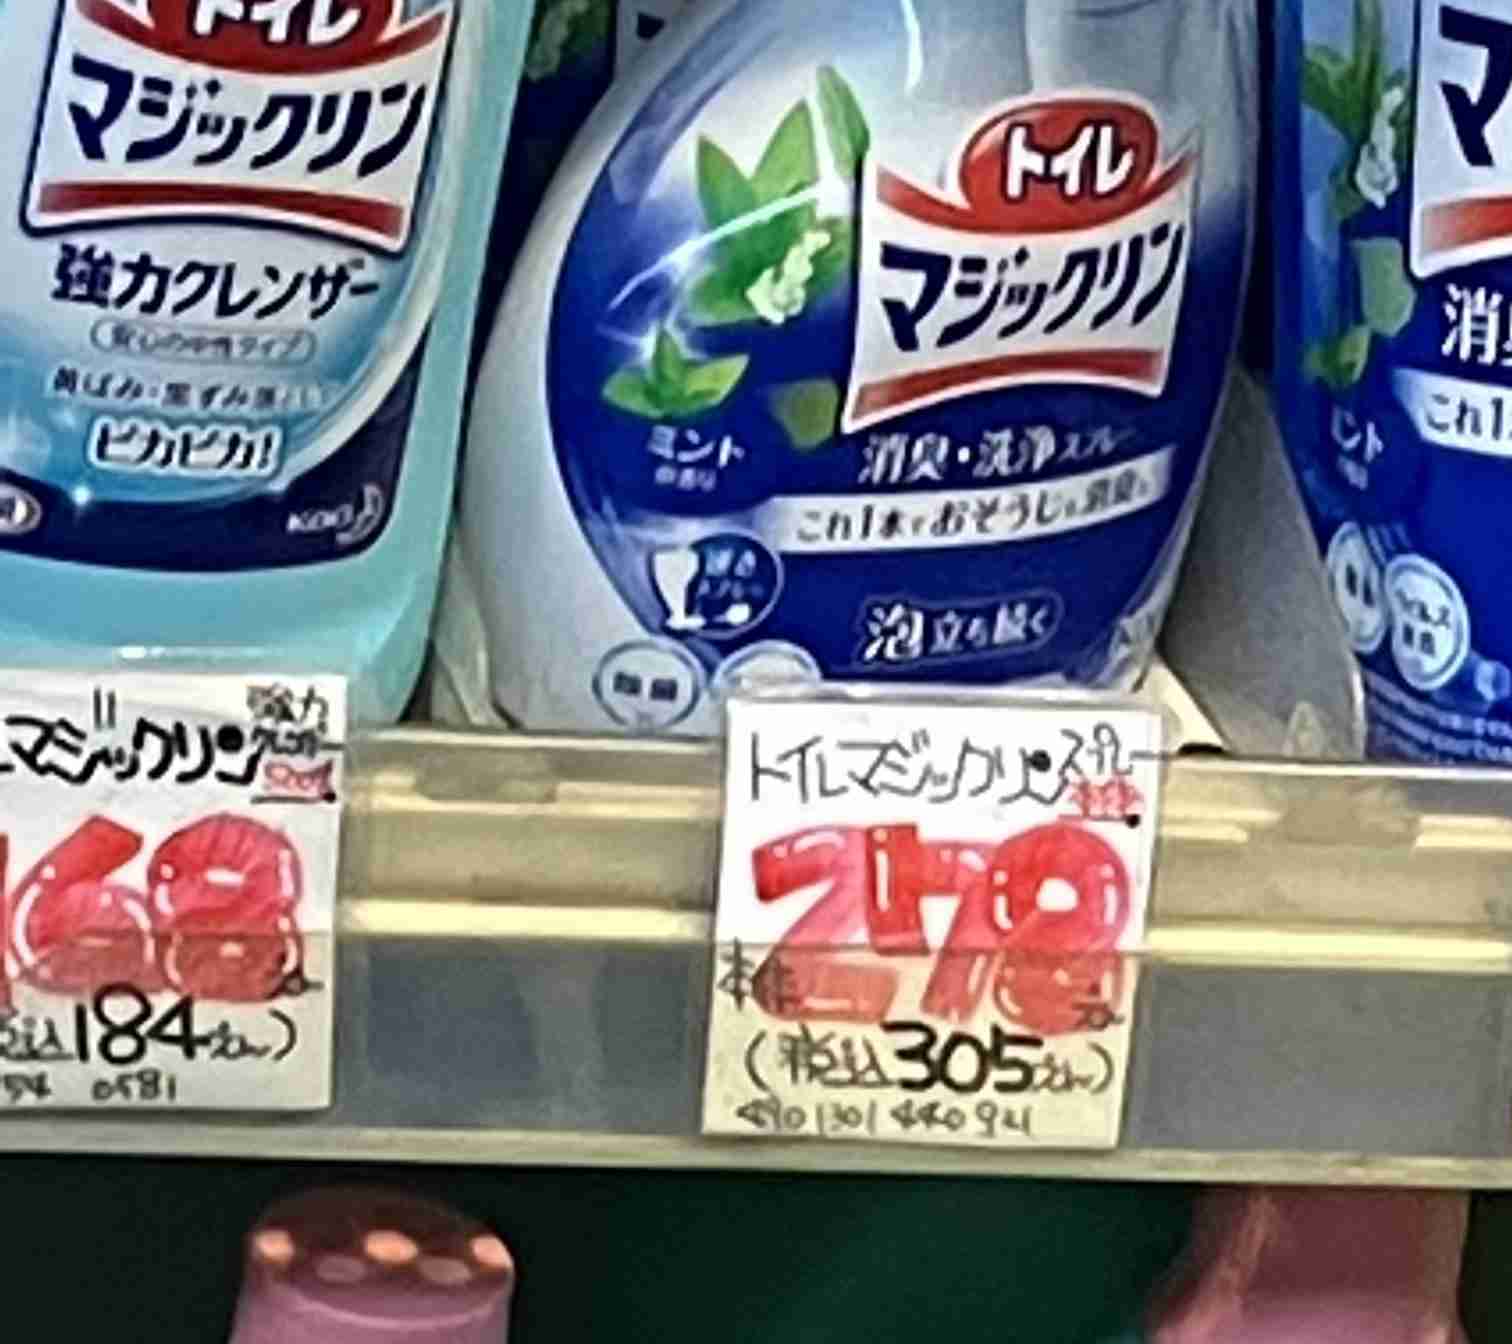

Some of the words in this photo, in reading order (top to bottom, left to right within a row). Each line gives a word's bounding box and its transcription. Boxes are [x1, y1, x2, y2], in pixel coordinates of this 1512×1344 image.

[68, 52, 429, 179] マジックリン
[1005, 119, 1136, 200] トイレ
[51, 243, 380, 321] 強力クレンザー
[879, 221, 1185, 352] マジックリン
[0, 687, 266, 786] マジックリン
[0, 814, 302, 1000] 68
[752, 822, 1132, 1038] 278
